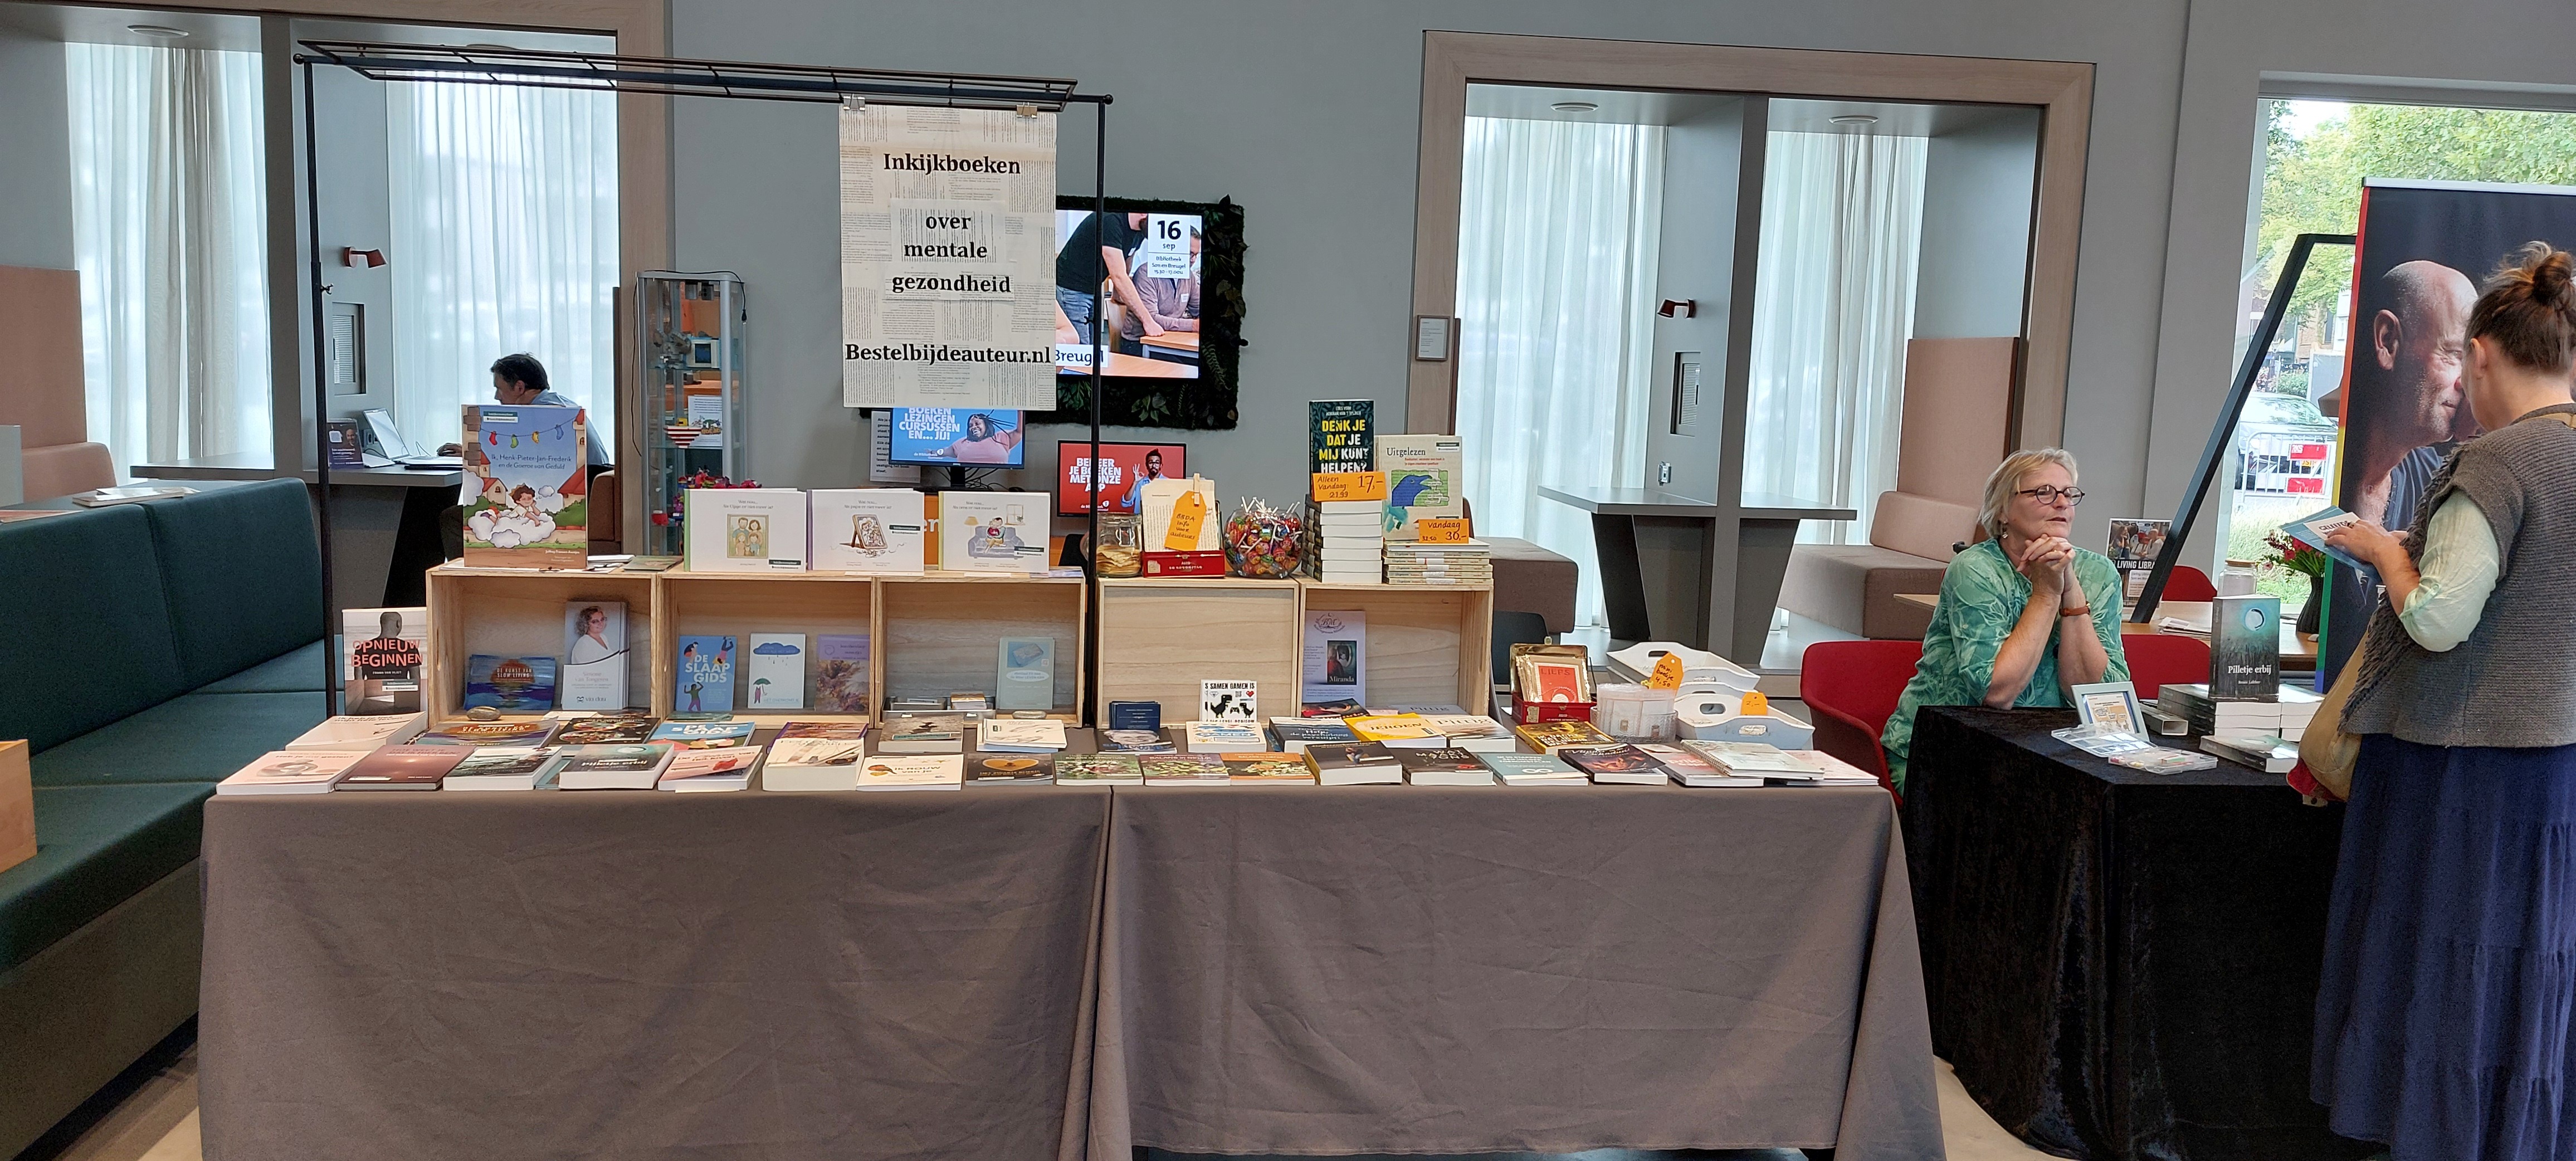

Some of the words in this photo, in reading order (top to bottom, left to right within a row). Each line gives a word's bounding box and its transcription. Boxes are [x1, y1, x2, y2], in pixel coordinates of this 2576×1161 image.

[884, 153, 1021, 175] Inkijkboeken
[925, 215, 972, 230] over
[1158, 220, 1181, 240] 16
[904, 242, 988, 259] mentale
[892, 276, 1011, 295] gezondheid
[845, 344, 1051, 364] Bestelbijdeauteur.nl
[904, 413, 955, 423] LEZINGEN
[899, 422, 960, 432] CURSUSSEN
[1321, 419, 1350, 432] DENK
[1352, 419, 1365, 431] JE
[908, 431, 933, 440] EN...
[935, 431, 950, 440] JIJ!
[1326, 434, 1346, 446] DAT
[1348, 433, 1361, 445] JE
[1319, 448, 1338, 460] MIJ
[1341, 448, 1369, 460] KUNT
[1387, 447, 1426, 457] Uitgelezen
[1076, 457, 1115, 467] BEEER
[1069, 466, 1079, 475] JE
[1320, 462, 1367, 474] HELPEN?
[1085, 482, 1106, 492] AP
[2117, 560, 2136, 569] LIVING
[353, 638, 420, 653] OPNIEUW
[351, 653, 423, 667] BEGINNEN
[694, 654, 708, 663] DE
[685, 662, 730, 673] SLAAP
[2228, 665, 2253, 676] Pilletje
[2255, 665, 2272, 676] erbij
[693, 672, 727, 683] GIDS
